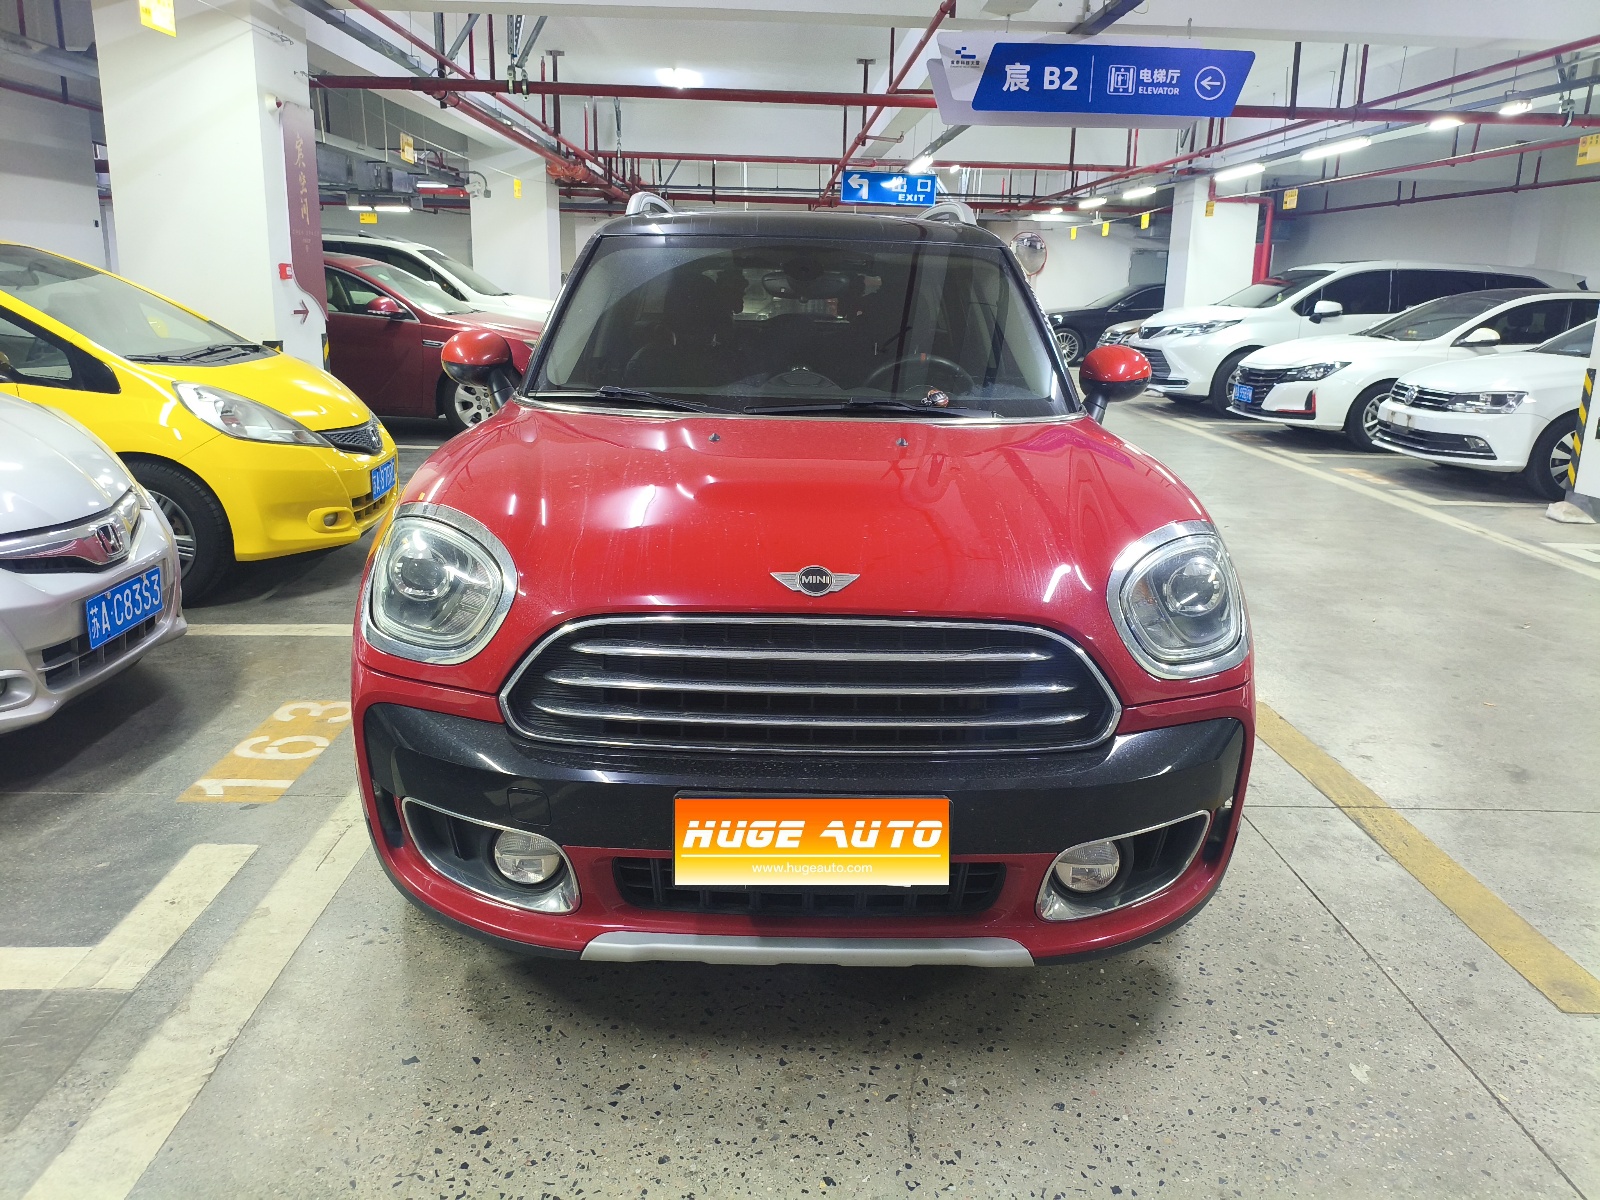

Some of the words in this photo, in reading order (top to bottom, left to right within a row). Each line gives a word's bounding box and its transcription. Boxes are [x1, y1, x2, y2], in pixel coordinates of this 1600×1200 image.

[1002, 62, 1030, 92] 宸
[1043, 66, 1079, 91] B2
[1140, 68, 1180, 84] 电梯厅
[1138, 86, 1180, 95] ELEVATOR
[889, 175, 932, 193] 出口
[898, 193, 926, 202] EXIT
[801, 575, 830, 584] MINI
[195, 701, 351, 797] 163
